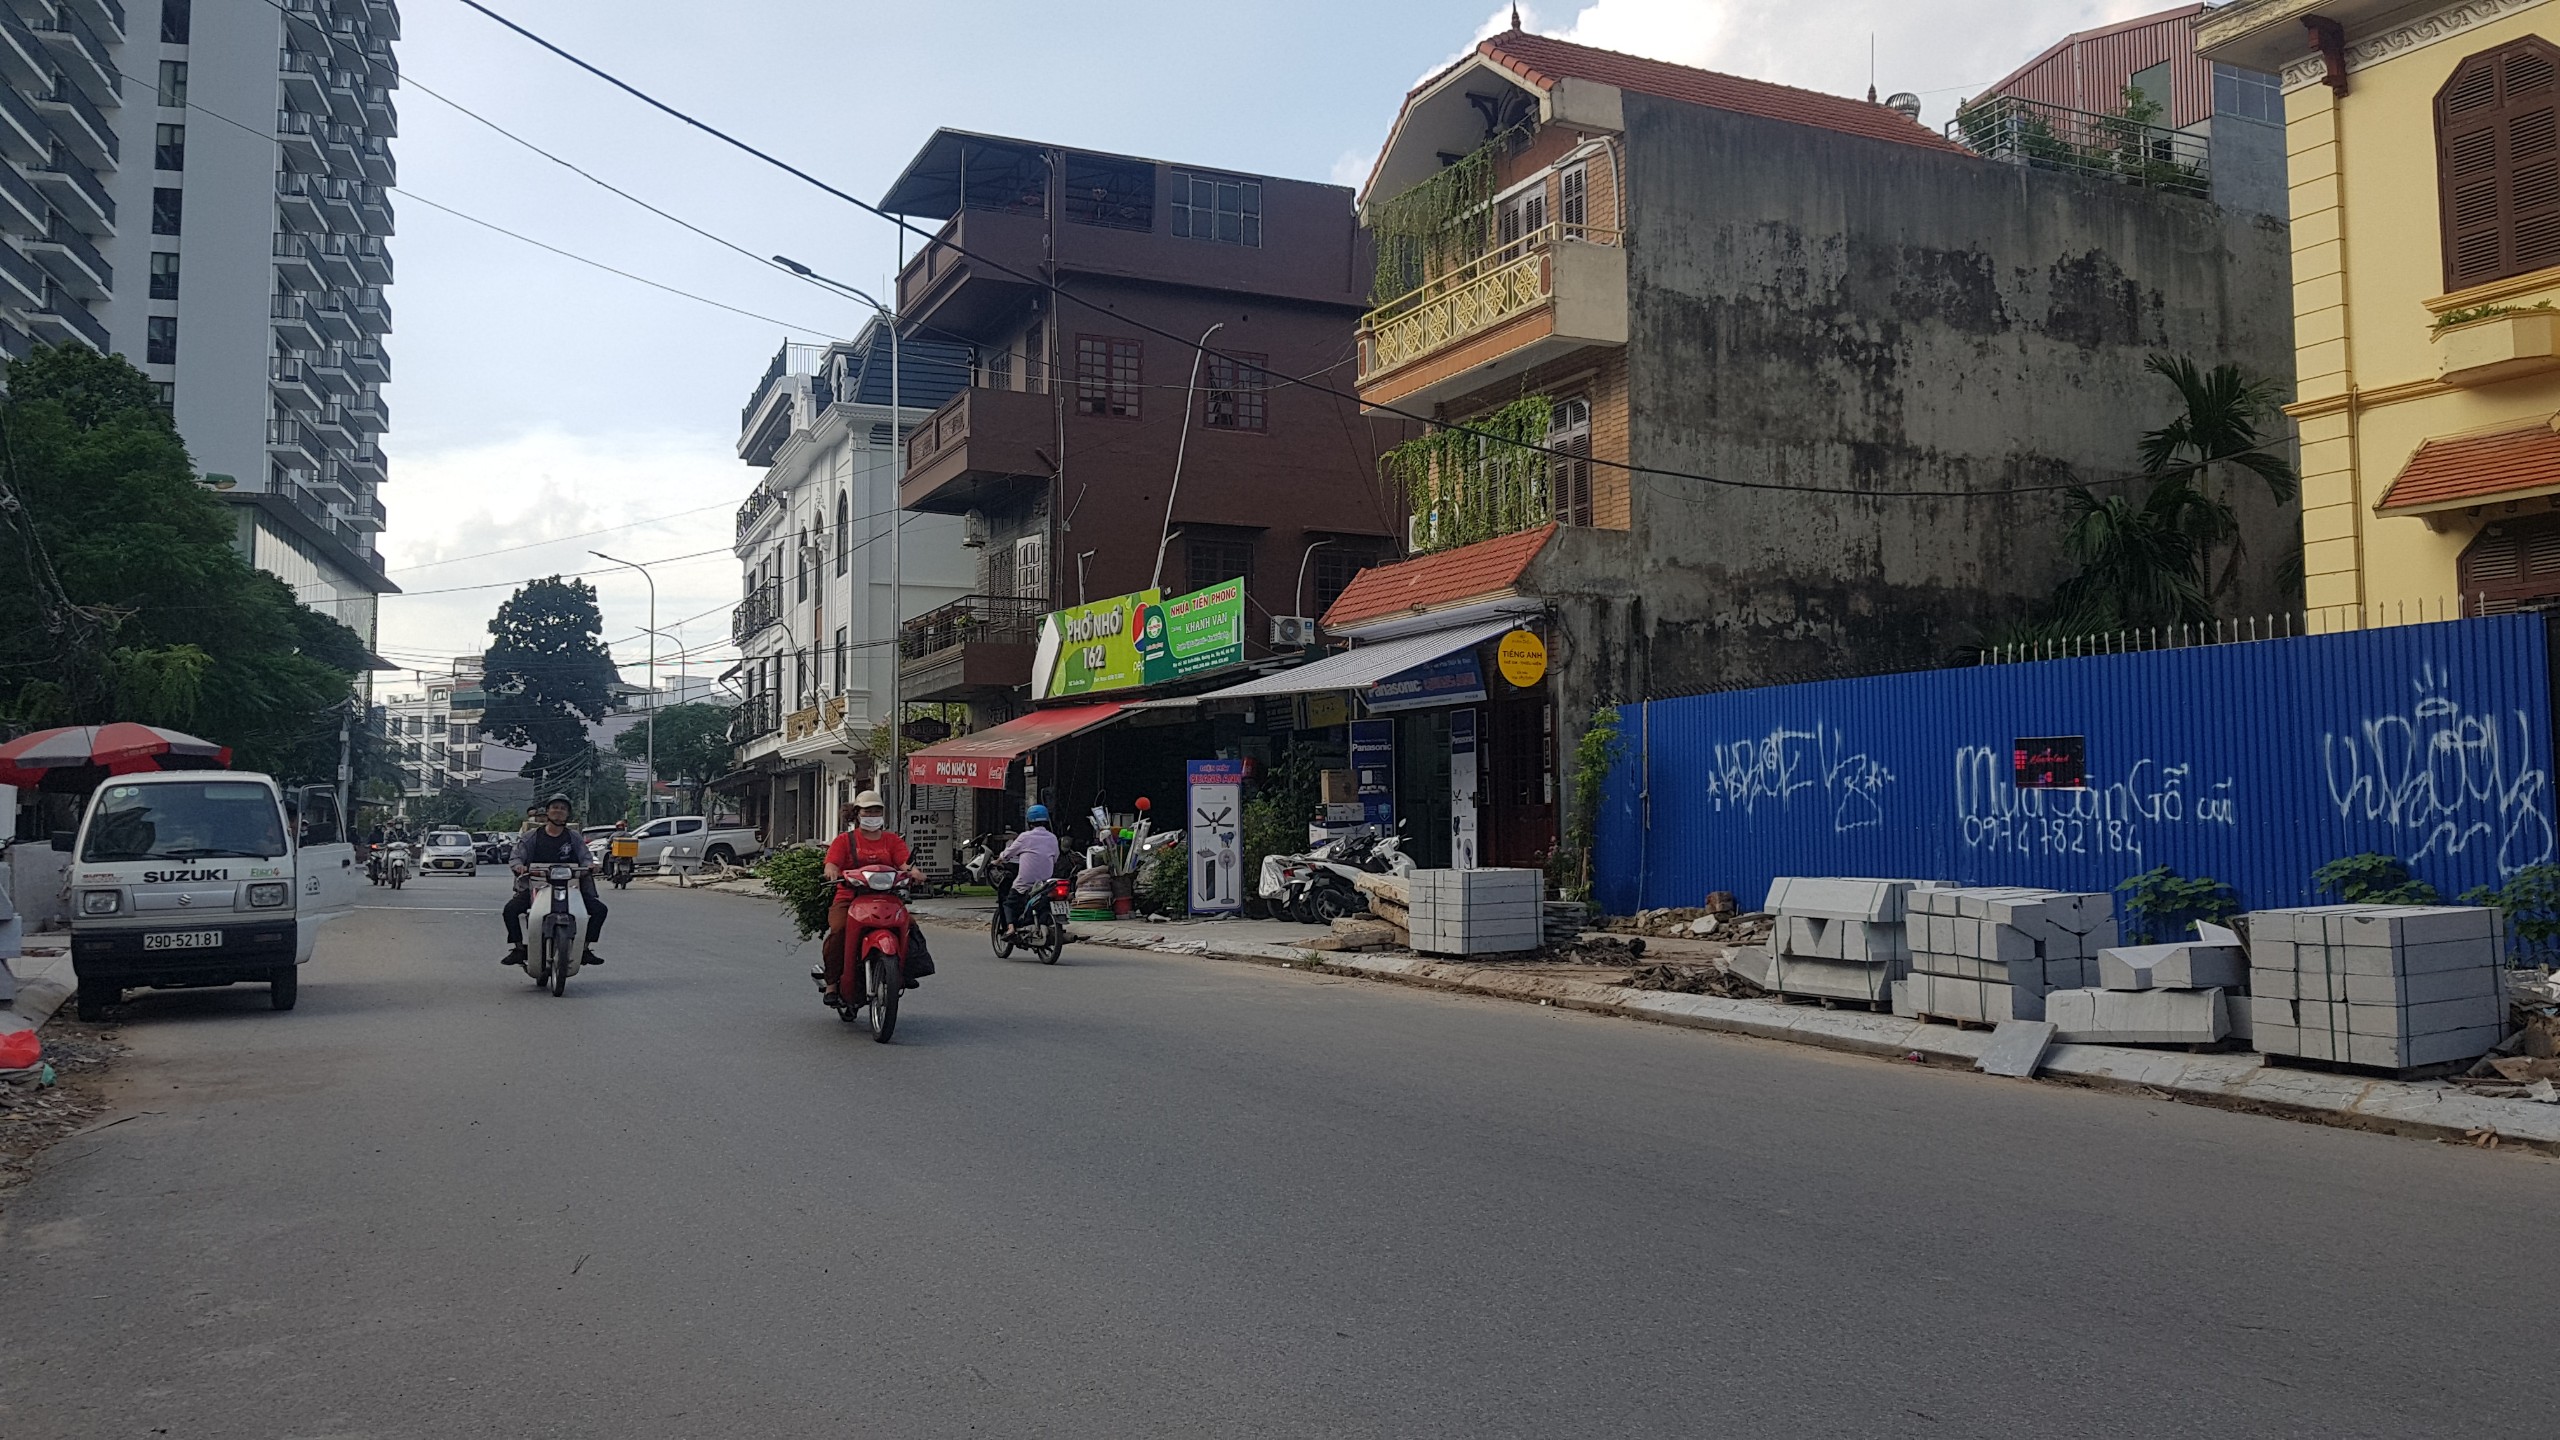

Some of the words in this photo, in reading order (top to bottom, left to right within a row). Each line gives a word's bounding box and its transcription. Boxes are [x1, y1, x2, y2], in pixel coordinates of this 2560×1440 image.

[1210, 586, 1237, 606] PHONG
[1083, 645, 1105, 669] 162
[1352, 742, 1392, 752] Panasonic
[143, 868, 229, 884] SUZUKI
